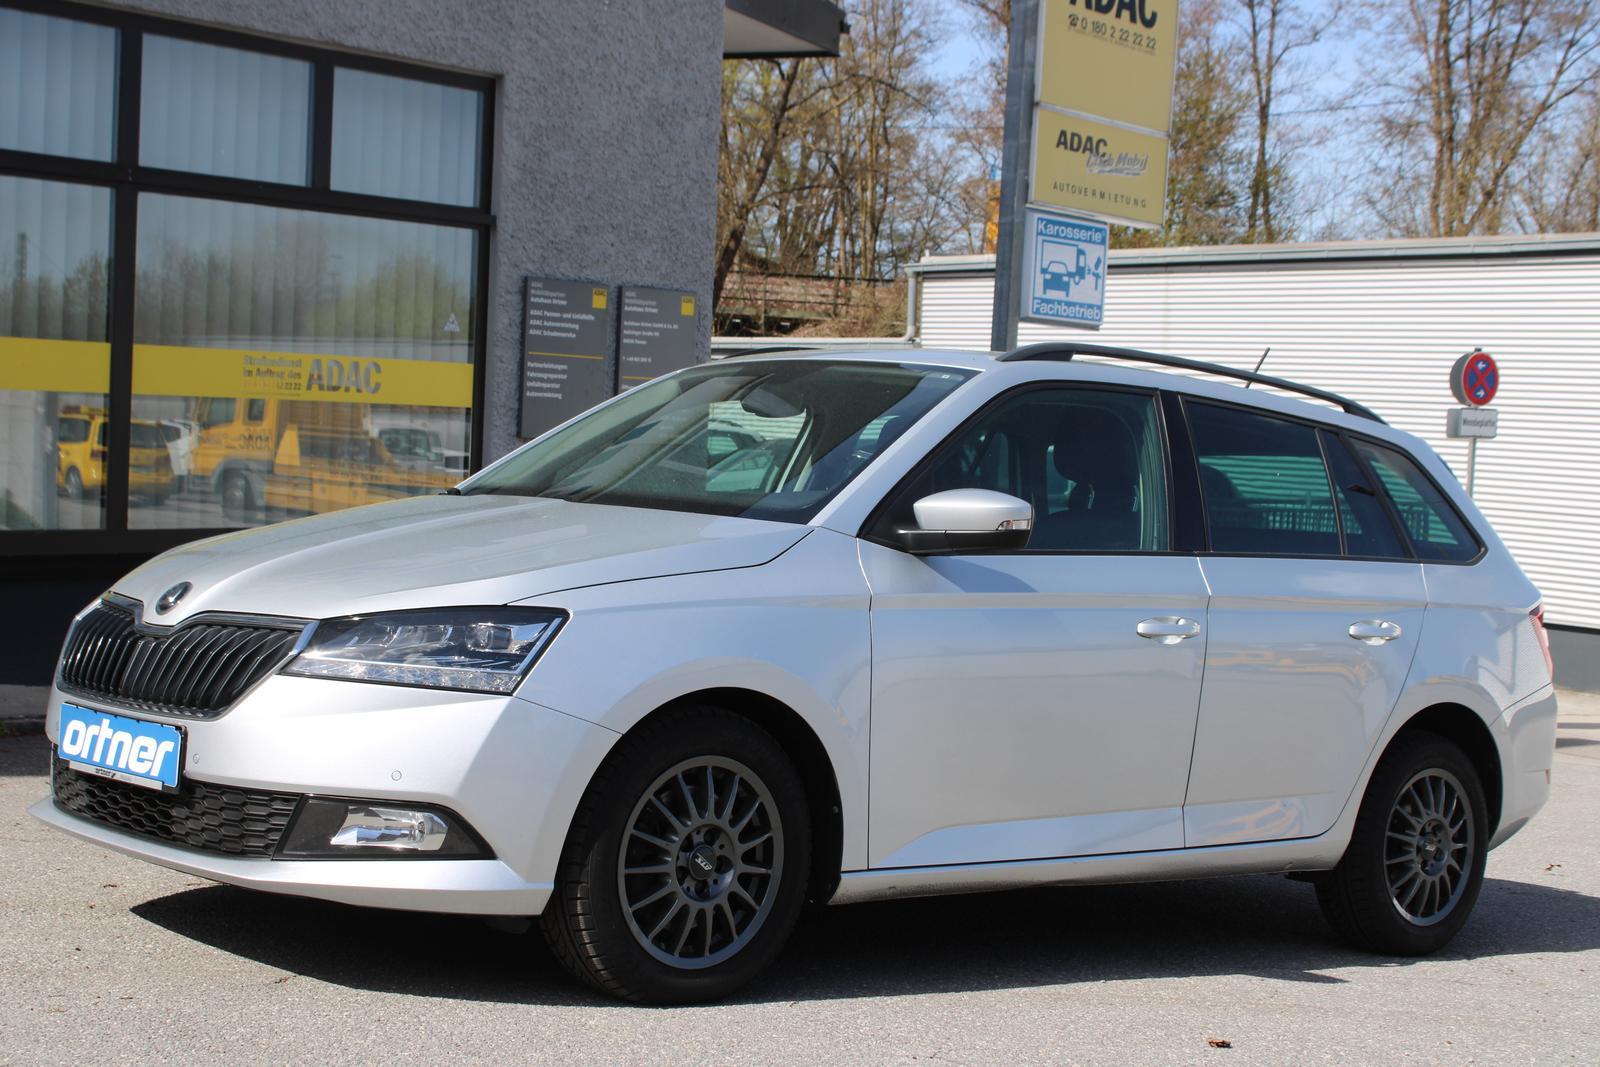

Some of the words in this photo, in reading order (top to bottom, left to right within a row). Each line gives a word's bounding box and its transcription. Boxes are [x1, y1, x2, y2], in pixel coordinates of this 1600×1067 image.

[1069, 0, 1158, 29] AC
[1081, 17, 1088, 30] 0
[1091, 20, 1107, 36] 180
[1110, 26, 1116, 39] 2
[1119, 28, 1130, 42] 22
[1132, 32, 1143, 46] 22
[1145, 36, 1157, 50] 22
[1056, 129, 1108, 159] ADAC
[1052, 181, 1147, 209] AUTOVERMIETUNG
[1037, 220, 1102, 243] Karosserie
[1032, 299, 1101, 320] Fachbetrieb
[306, 358, 382, 395] ADAC
[62, 718, 175, 777] ortner
